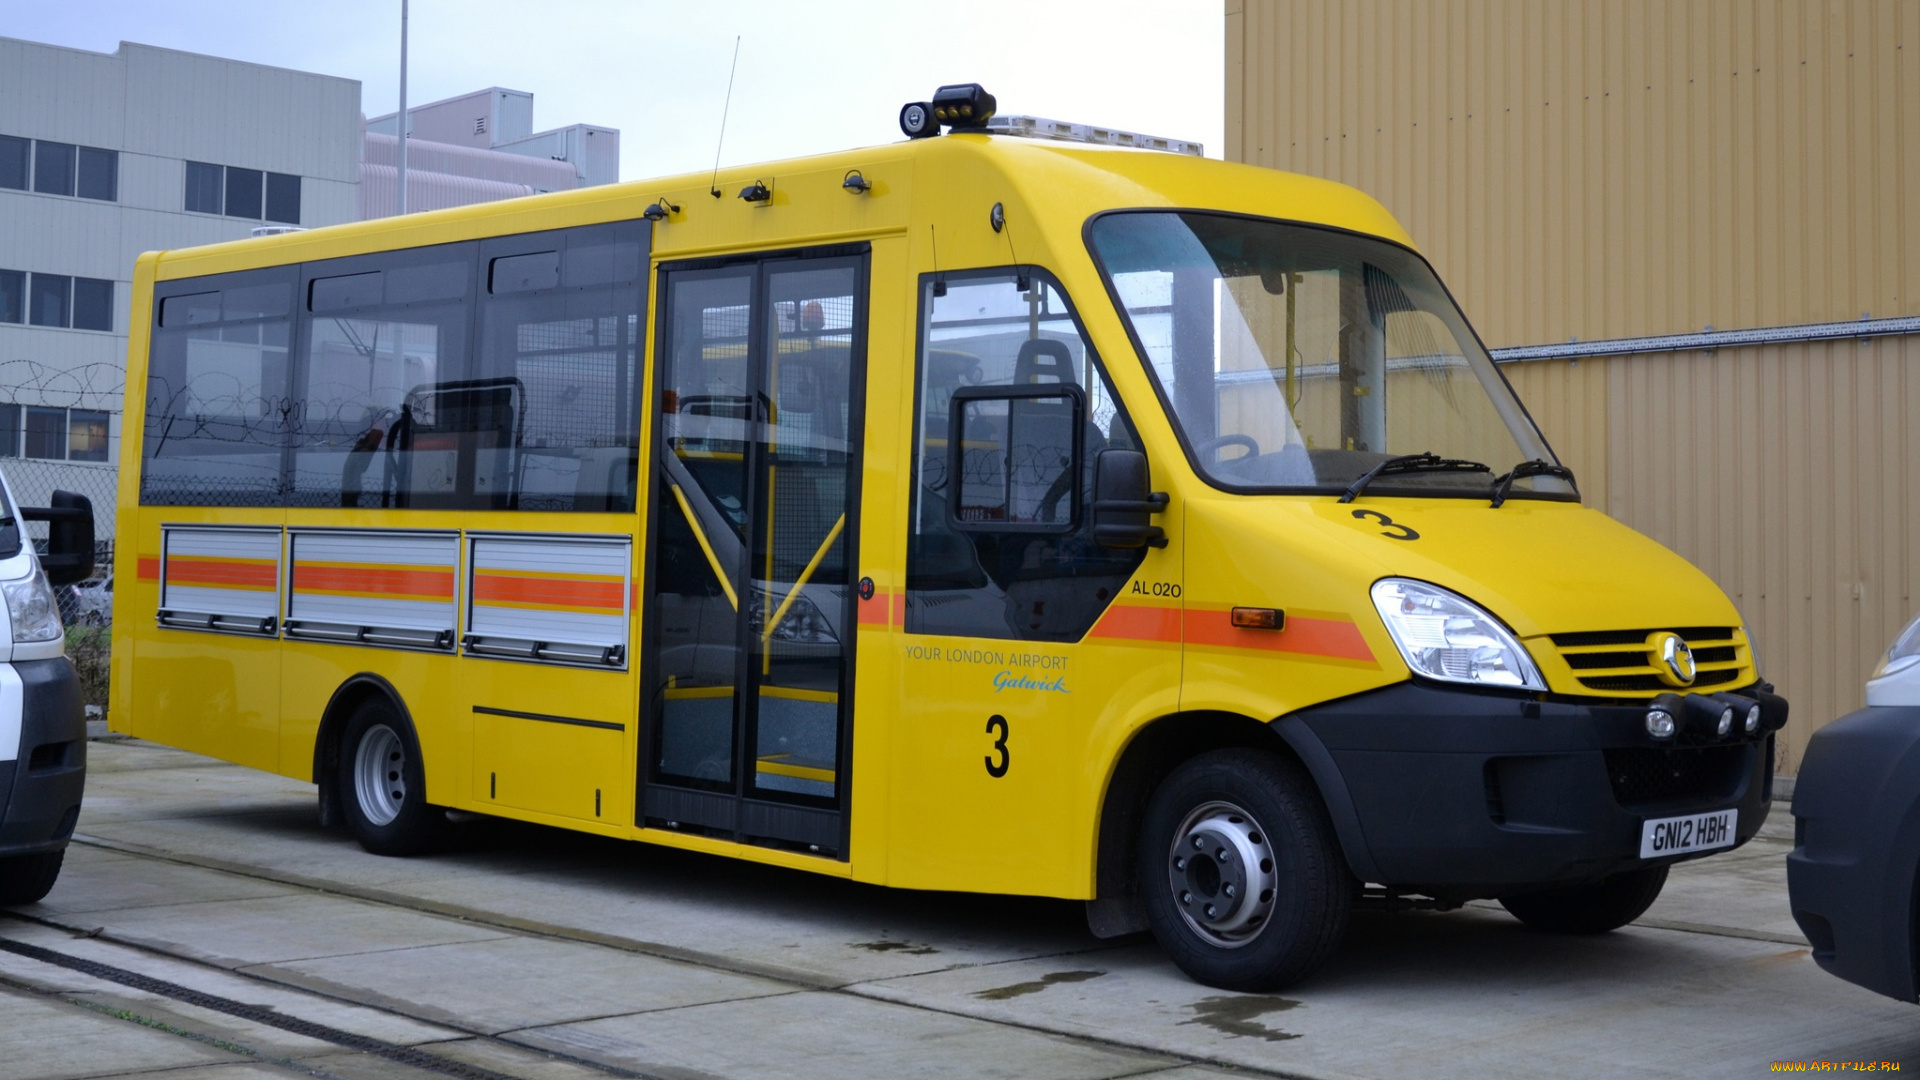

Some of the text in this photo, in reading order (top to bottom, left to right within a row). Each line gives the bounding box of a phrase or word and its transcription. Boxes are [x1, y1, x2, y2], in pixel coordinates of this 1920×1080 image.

[1351, 509, 1420, 541] 3
[906, 645, 1069, 670] YOUR LONDON AIRPORT
[993, 670, 1072, 693] Gatwick
[984, 714, 1010, 778] 3
[1653, 814, 1728, 851] GN12 HBH
